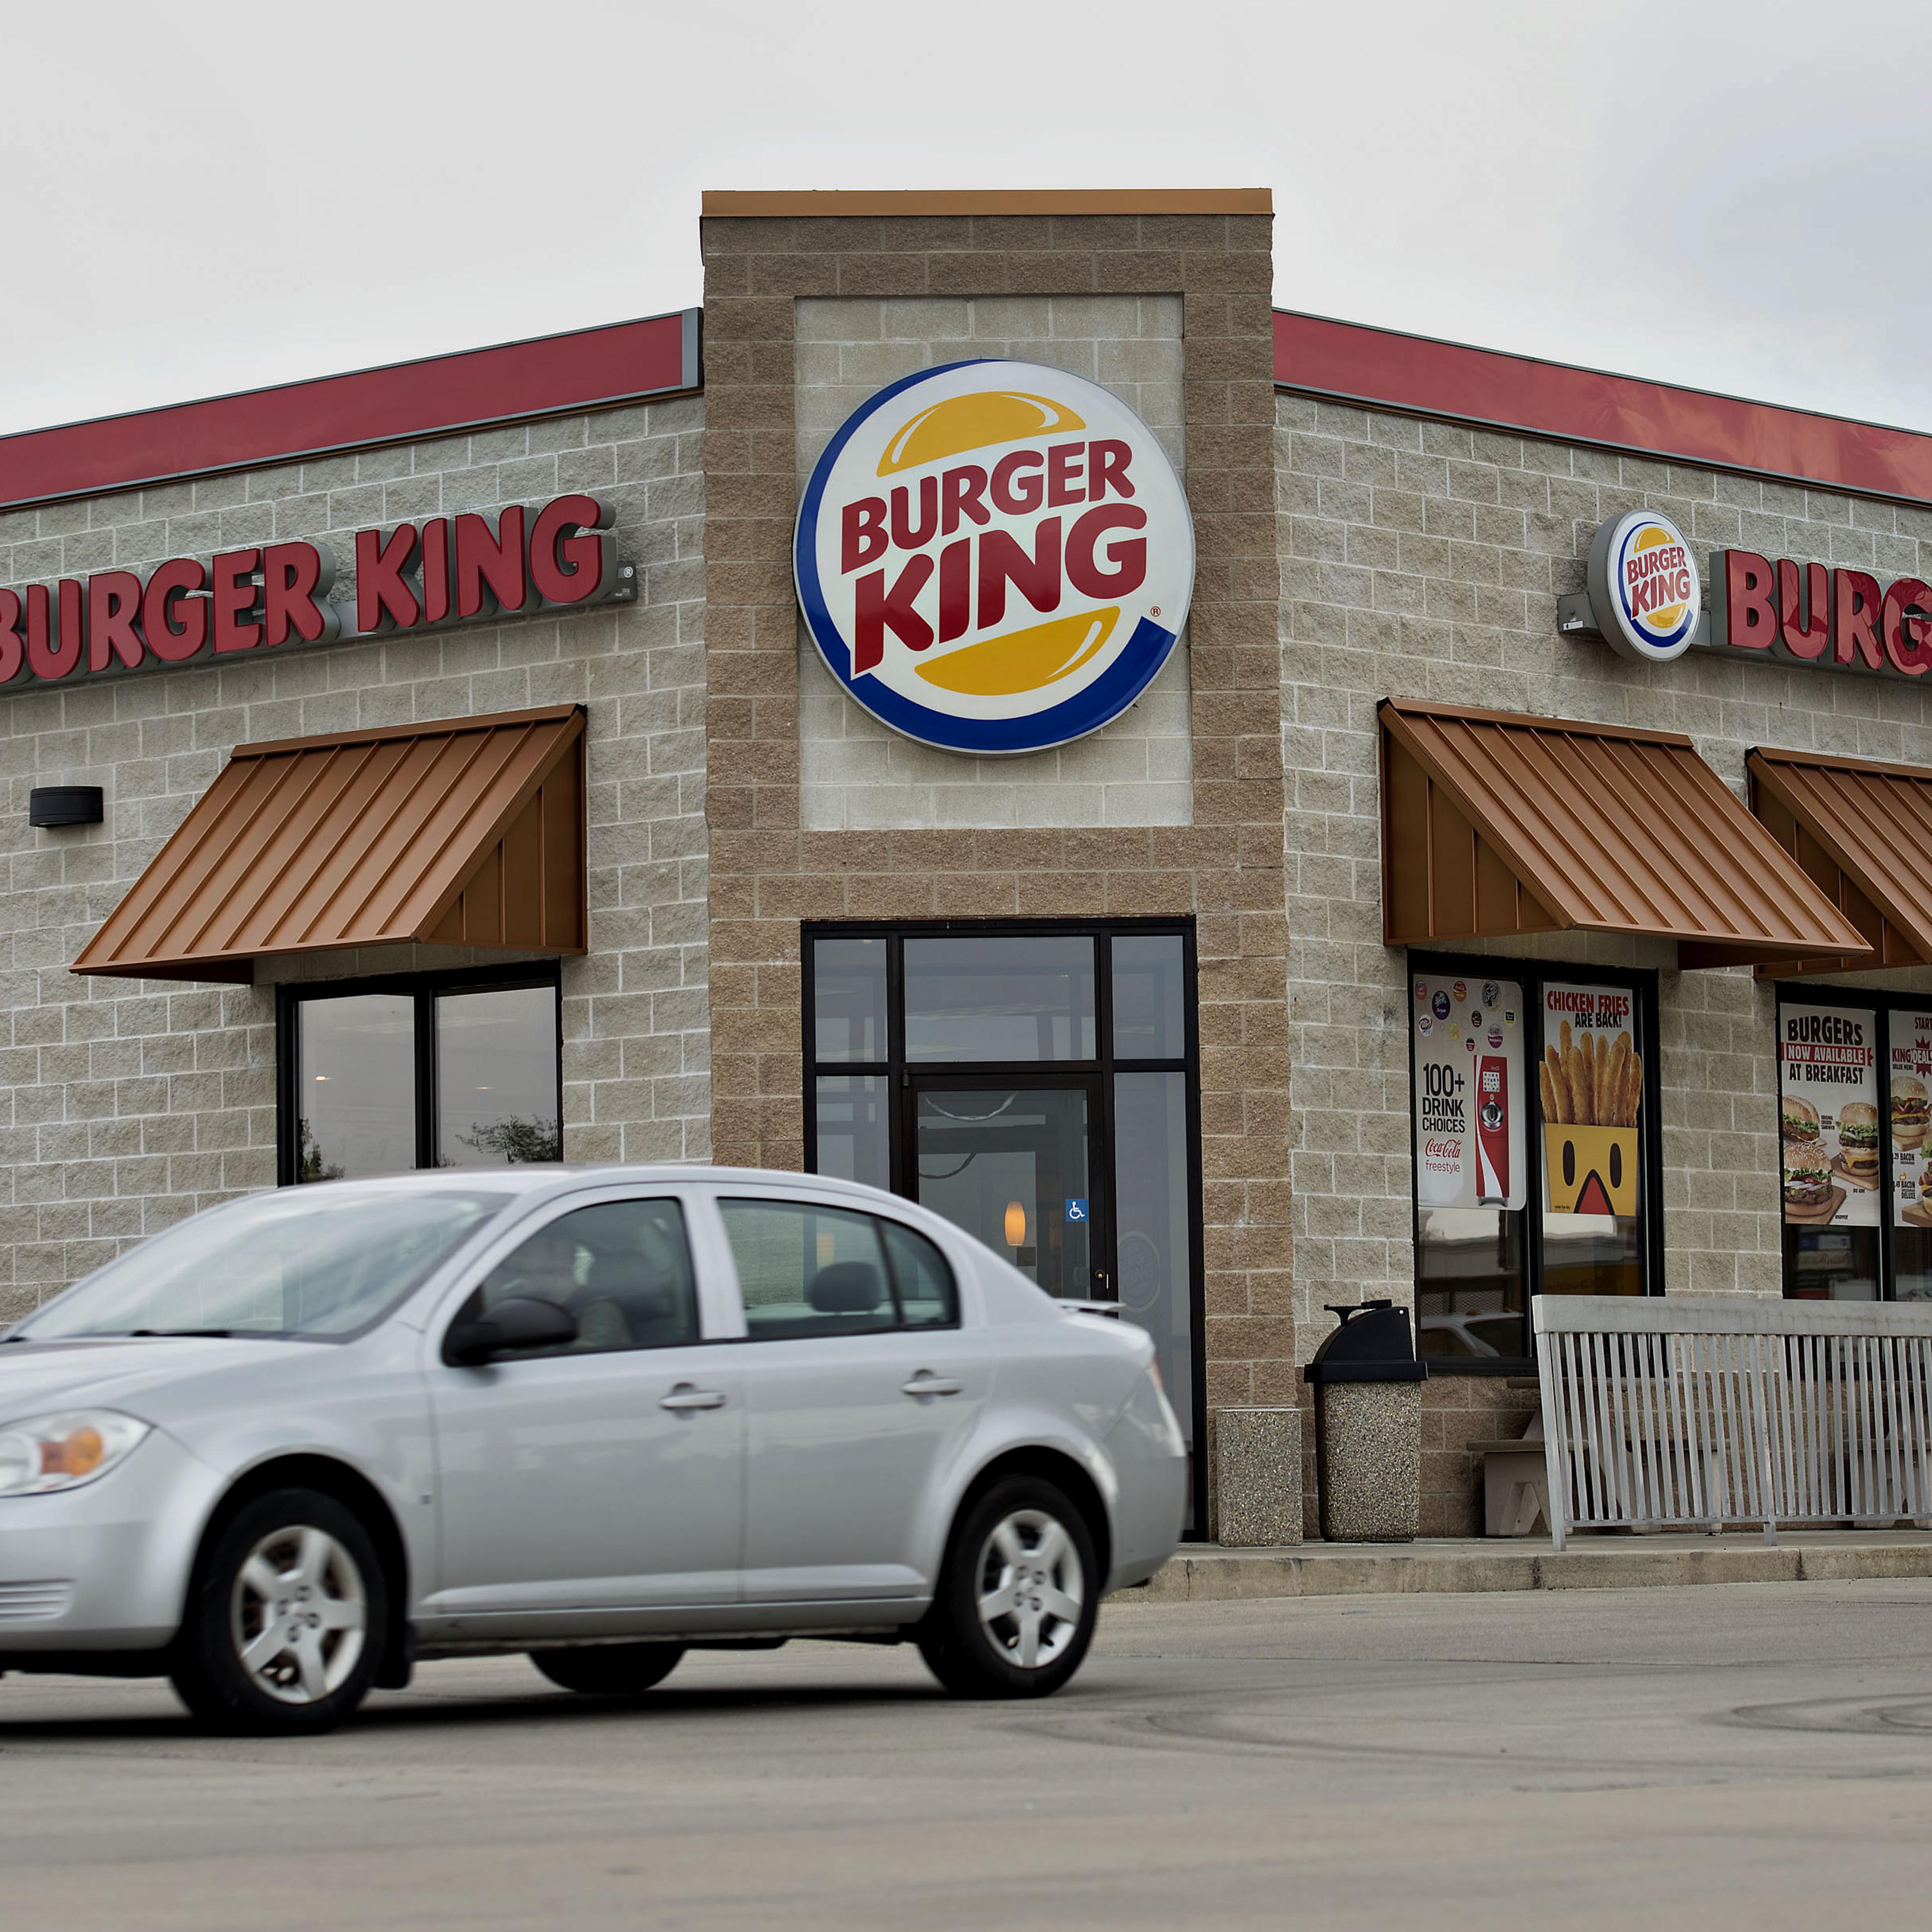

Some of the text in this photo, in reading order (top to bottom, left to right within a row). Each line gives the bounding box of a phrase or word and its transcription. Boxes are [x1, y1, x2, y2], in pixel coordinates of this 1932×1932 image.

[842, 439, 1135, 575] BURGER
[355, 495, 603, 633] KING
[1627, 546, 1686, 584] BURGER
[854, 503, 1148, 675] KING
[1631, 570, 1691, 620] KING
[1725, 549, 1932, 675] BURG
[1547, 990, 1629, 1016] CHICKEN FRIES
[1575, 1013, 1622, 1028] ARE BACK!
[1788, 1015, 1863, 1045] BURGERS
[1788, 1045, 1863, 1063] NOW AVAILABLE
[1892, 1048, 1911, 1063] KING
[1423, 1063, 1465, 1097] 100+
[1789, 1063, 1863, 1084] AT BREAKFAST
[1422, 1097, 1464, 1117] DRINK
[1422, 1117, 1465, 1133] CHOICES
[1425, 1160, 1460, 1174] freestyle
[1900, 1153, 1914, 1161] BACON
